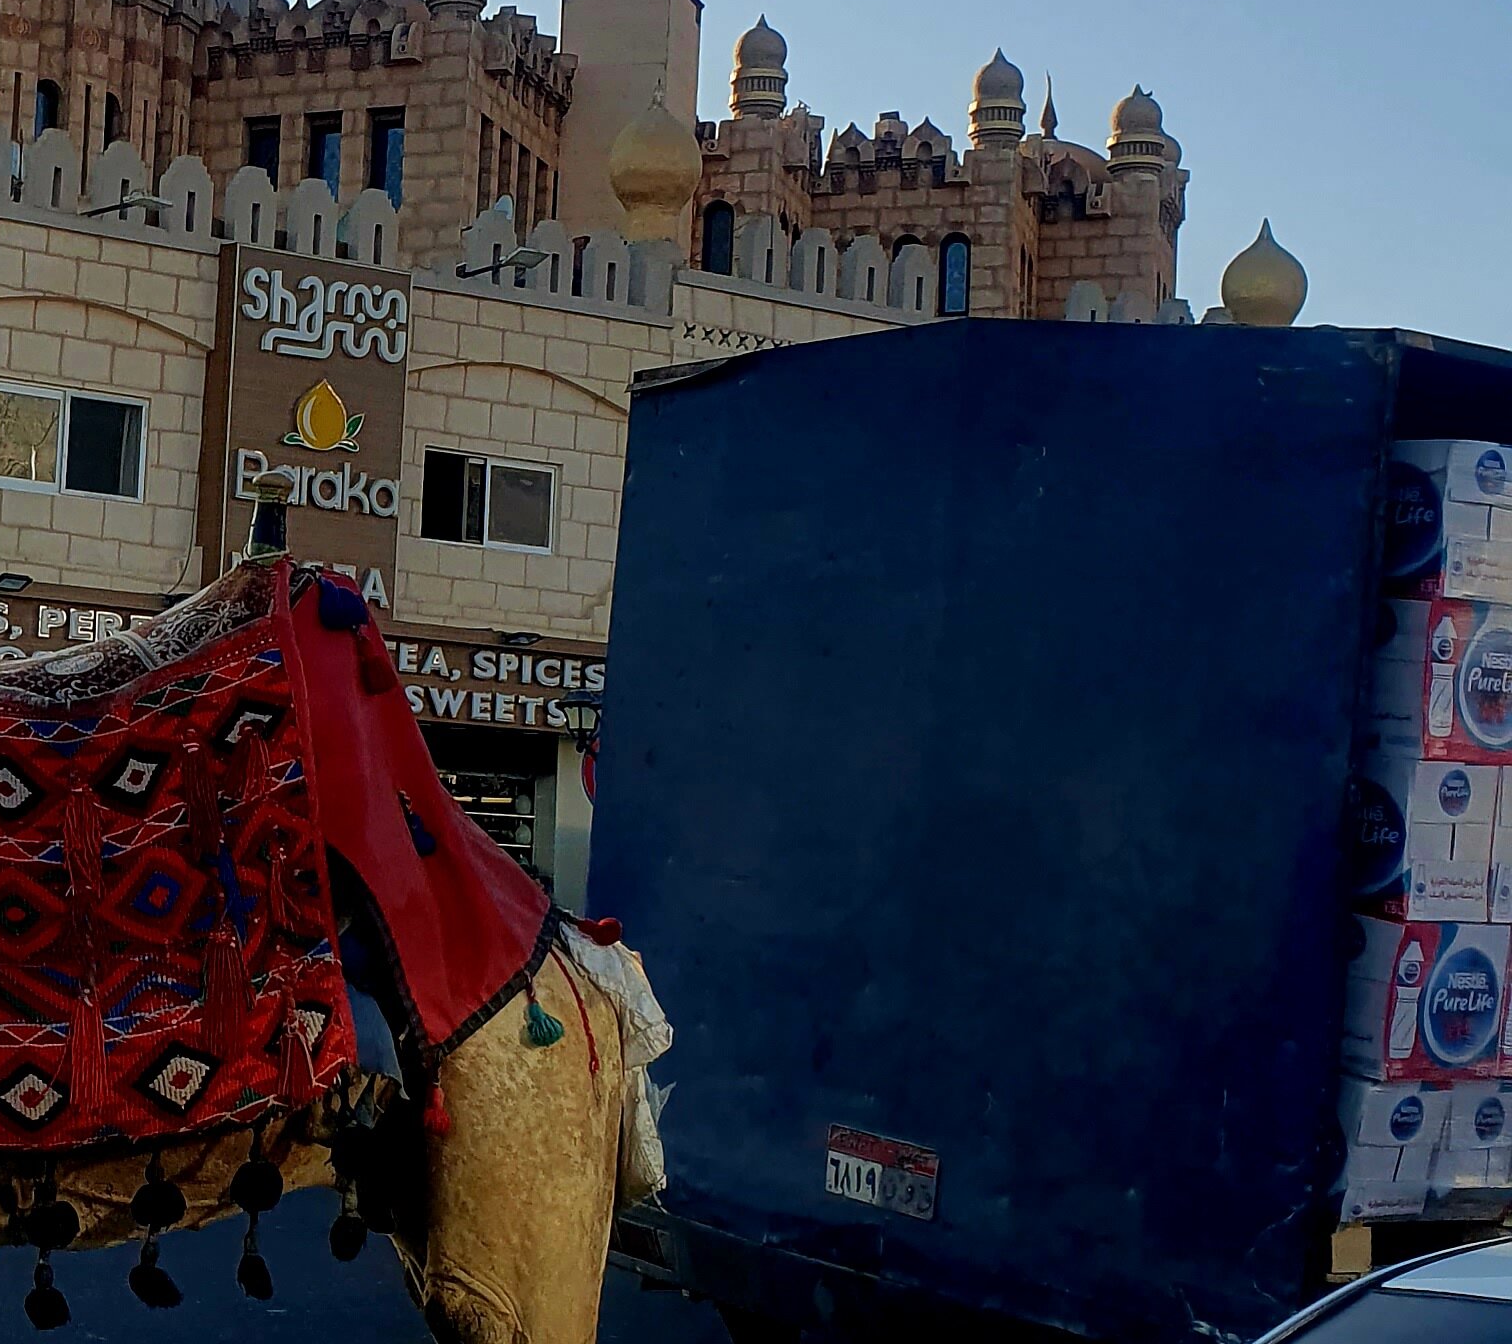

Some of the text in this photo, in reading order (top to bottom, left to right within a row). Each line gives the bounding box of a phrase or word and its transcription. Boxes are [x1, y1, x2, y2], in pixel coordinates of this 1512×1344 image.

[385, 640, 606, 692] EA, SPICES
[405, 685, 567, 727] SWEETS
